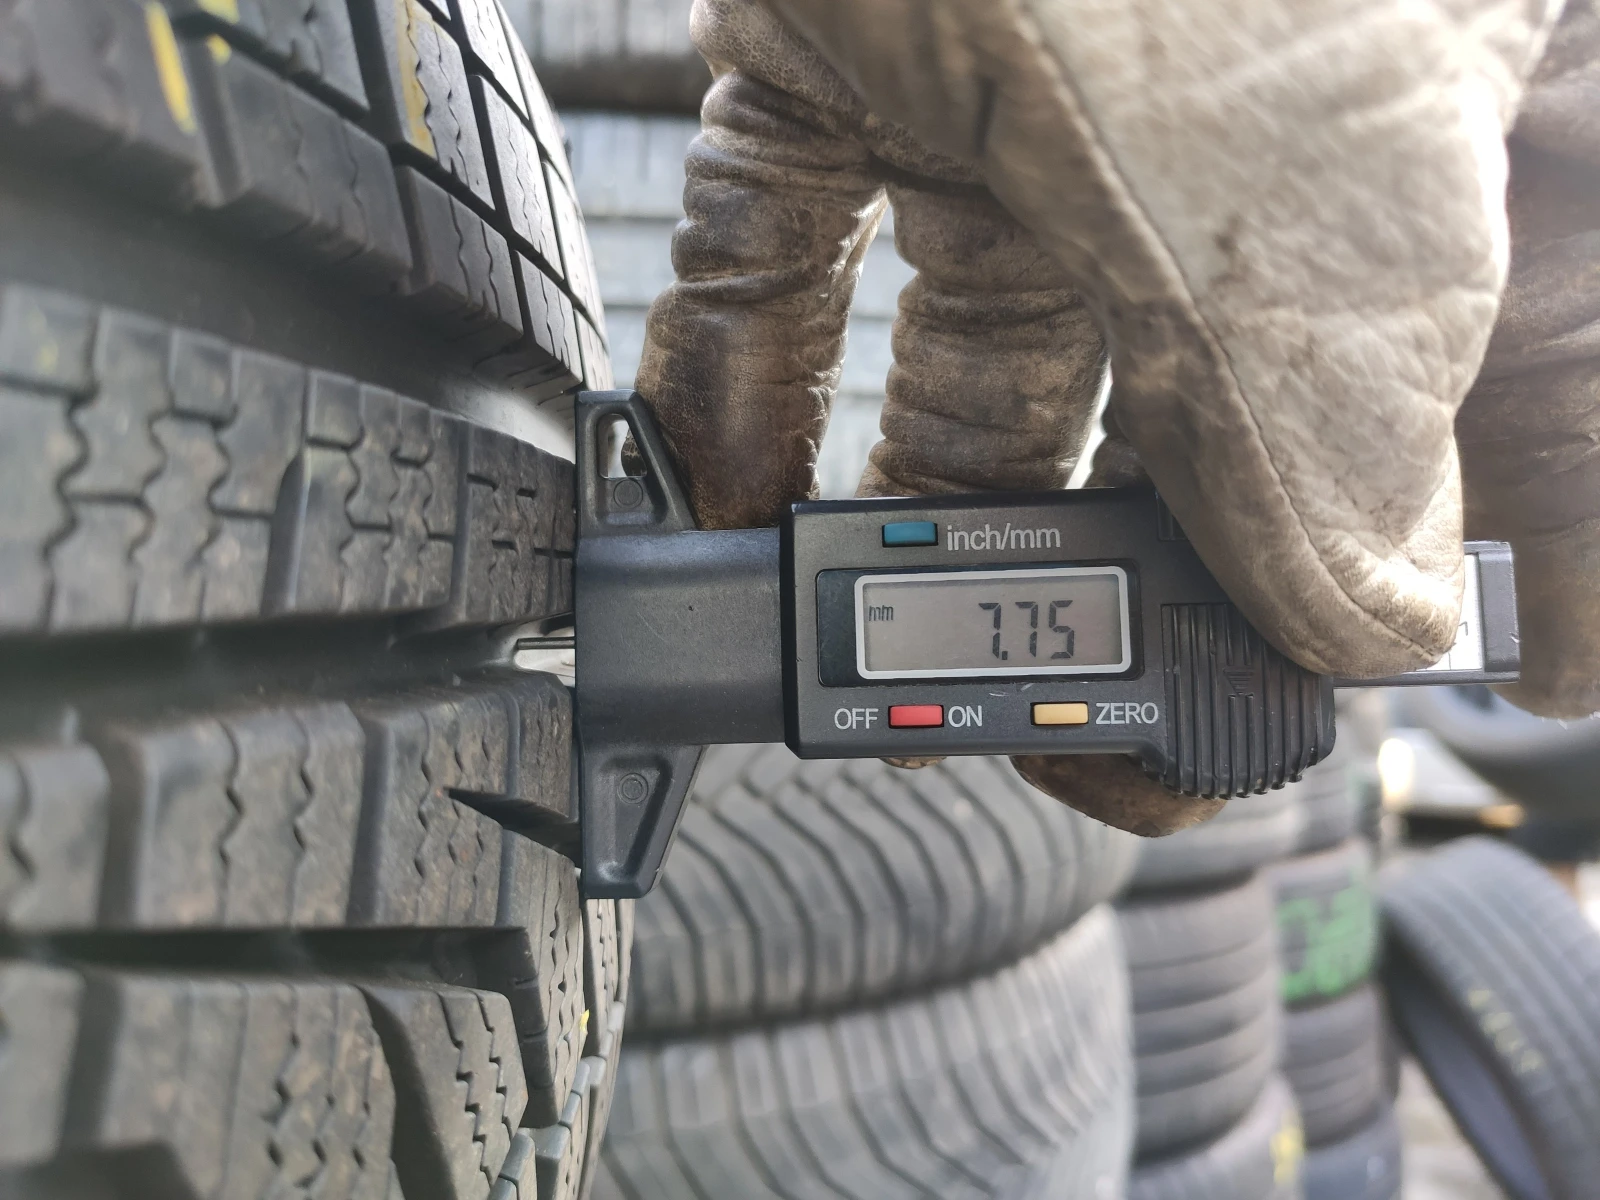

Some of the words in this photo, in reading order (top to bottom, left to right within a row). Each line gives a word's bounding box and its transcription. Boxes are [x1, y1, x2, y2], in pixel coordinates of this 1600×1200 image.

[946, 522, 1061, 551] inch/mm
[868, 604, 895, 622] mm
[978, 600, 1075, 660] 7.75
[834, 707, 880, 730] OFF
[947, 705, 983, 728] ON
[1095, 702, 1159, 725] ZERO
